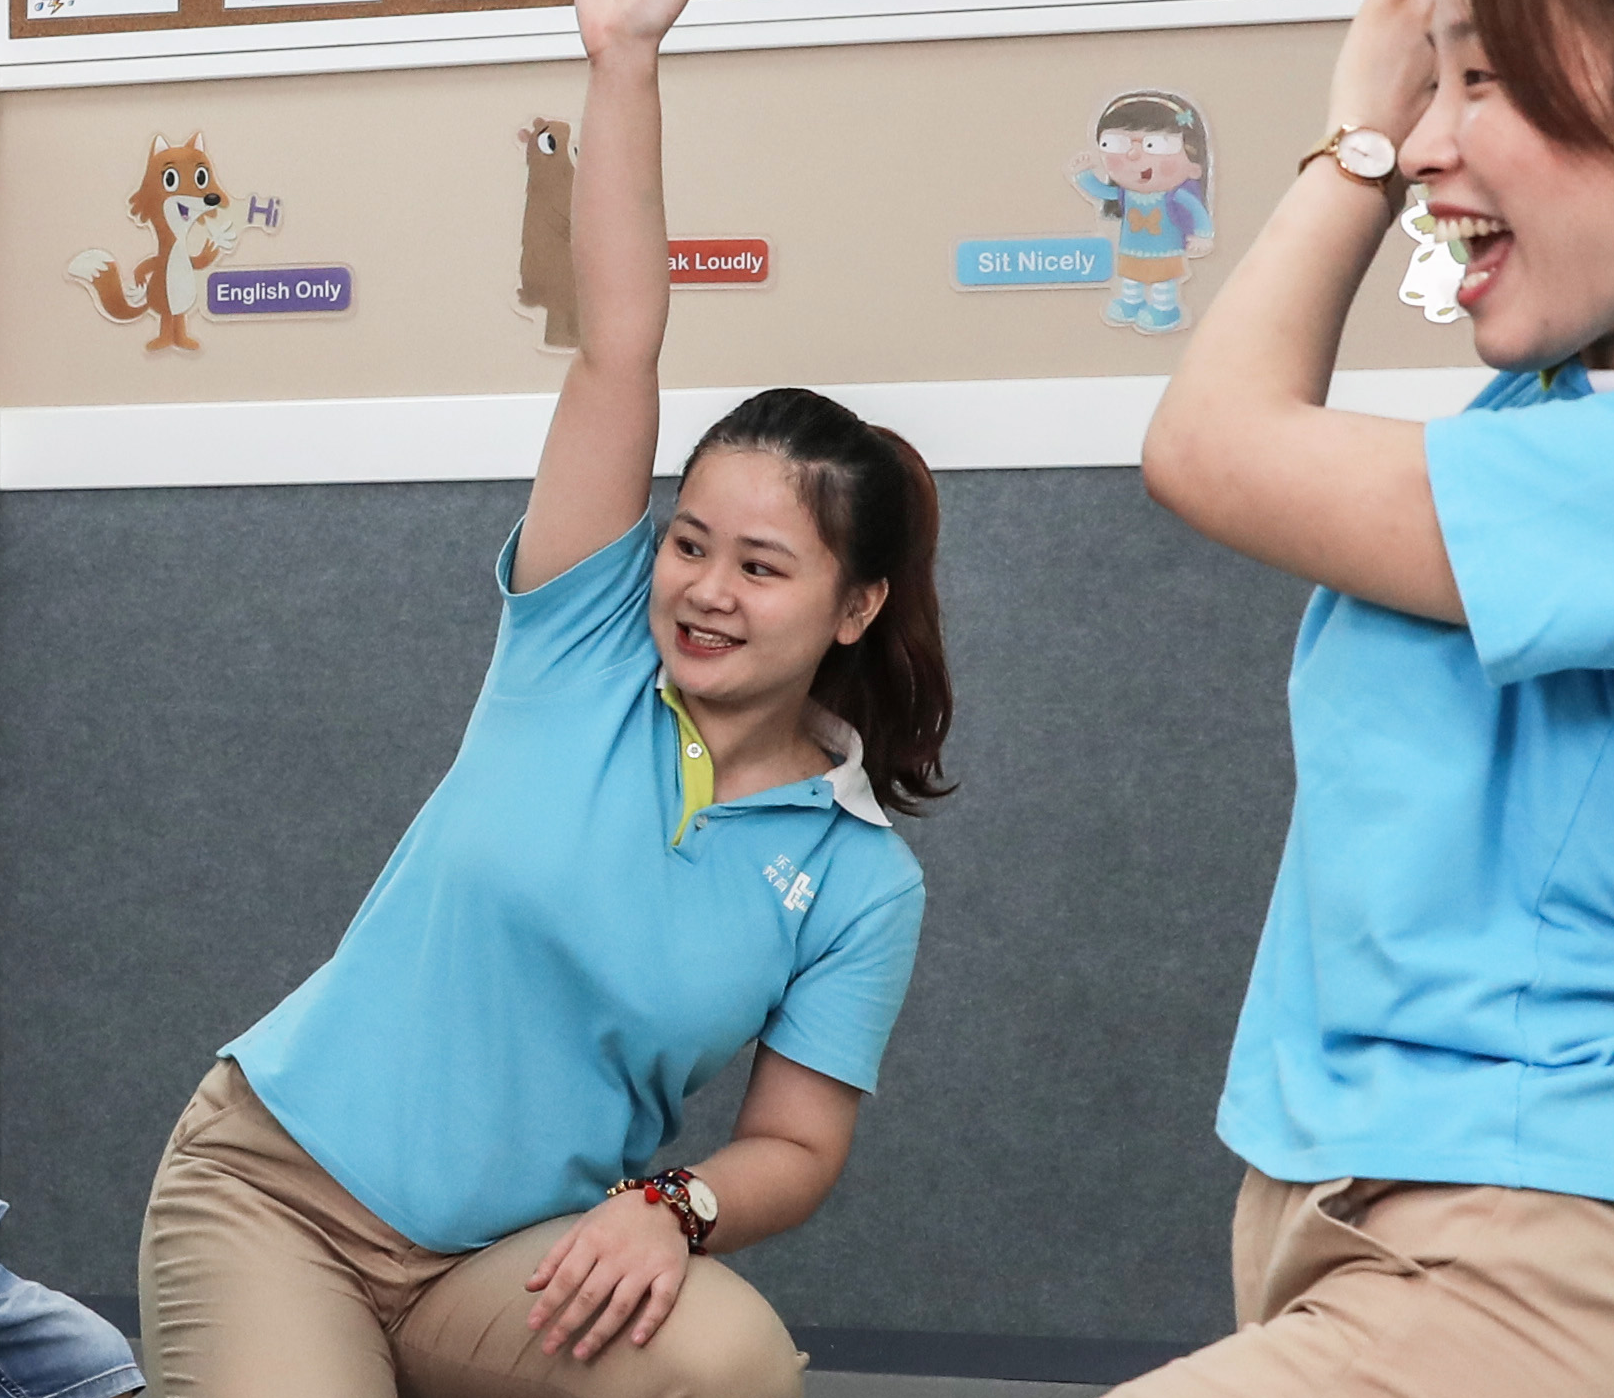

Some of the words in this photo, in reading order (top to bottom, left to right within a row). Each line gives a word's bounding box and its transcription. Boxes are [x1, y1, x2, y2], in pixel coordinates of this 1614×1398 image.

[246, 195, 280, 229] Hi
[695, 252, 763, 274] Loudly
[978, 252, 1012, 274] Sit
[1018, 250, 1096, 273] Nicely
[216, 281, 291, 302] English
[295, 279, 342, 302] Only
